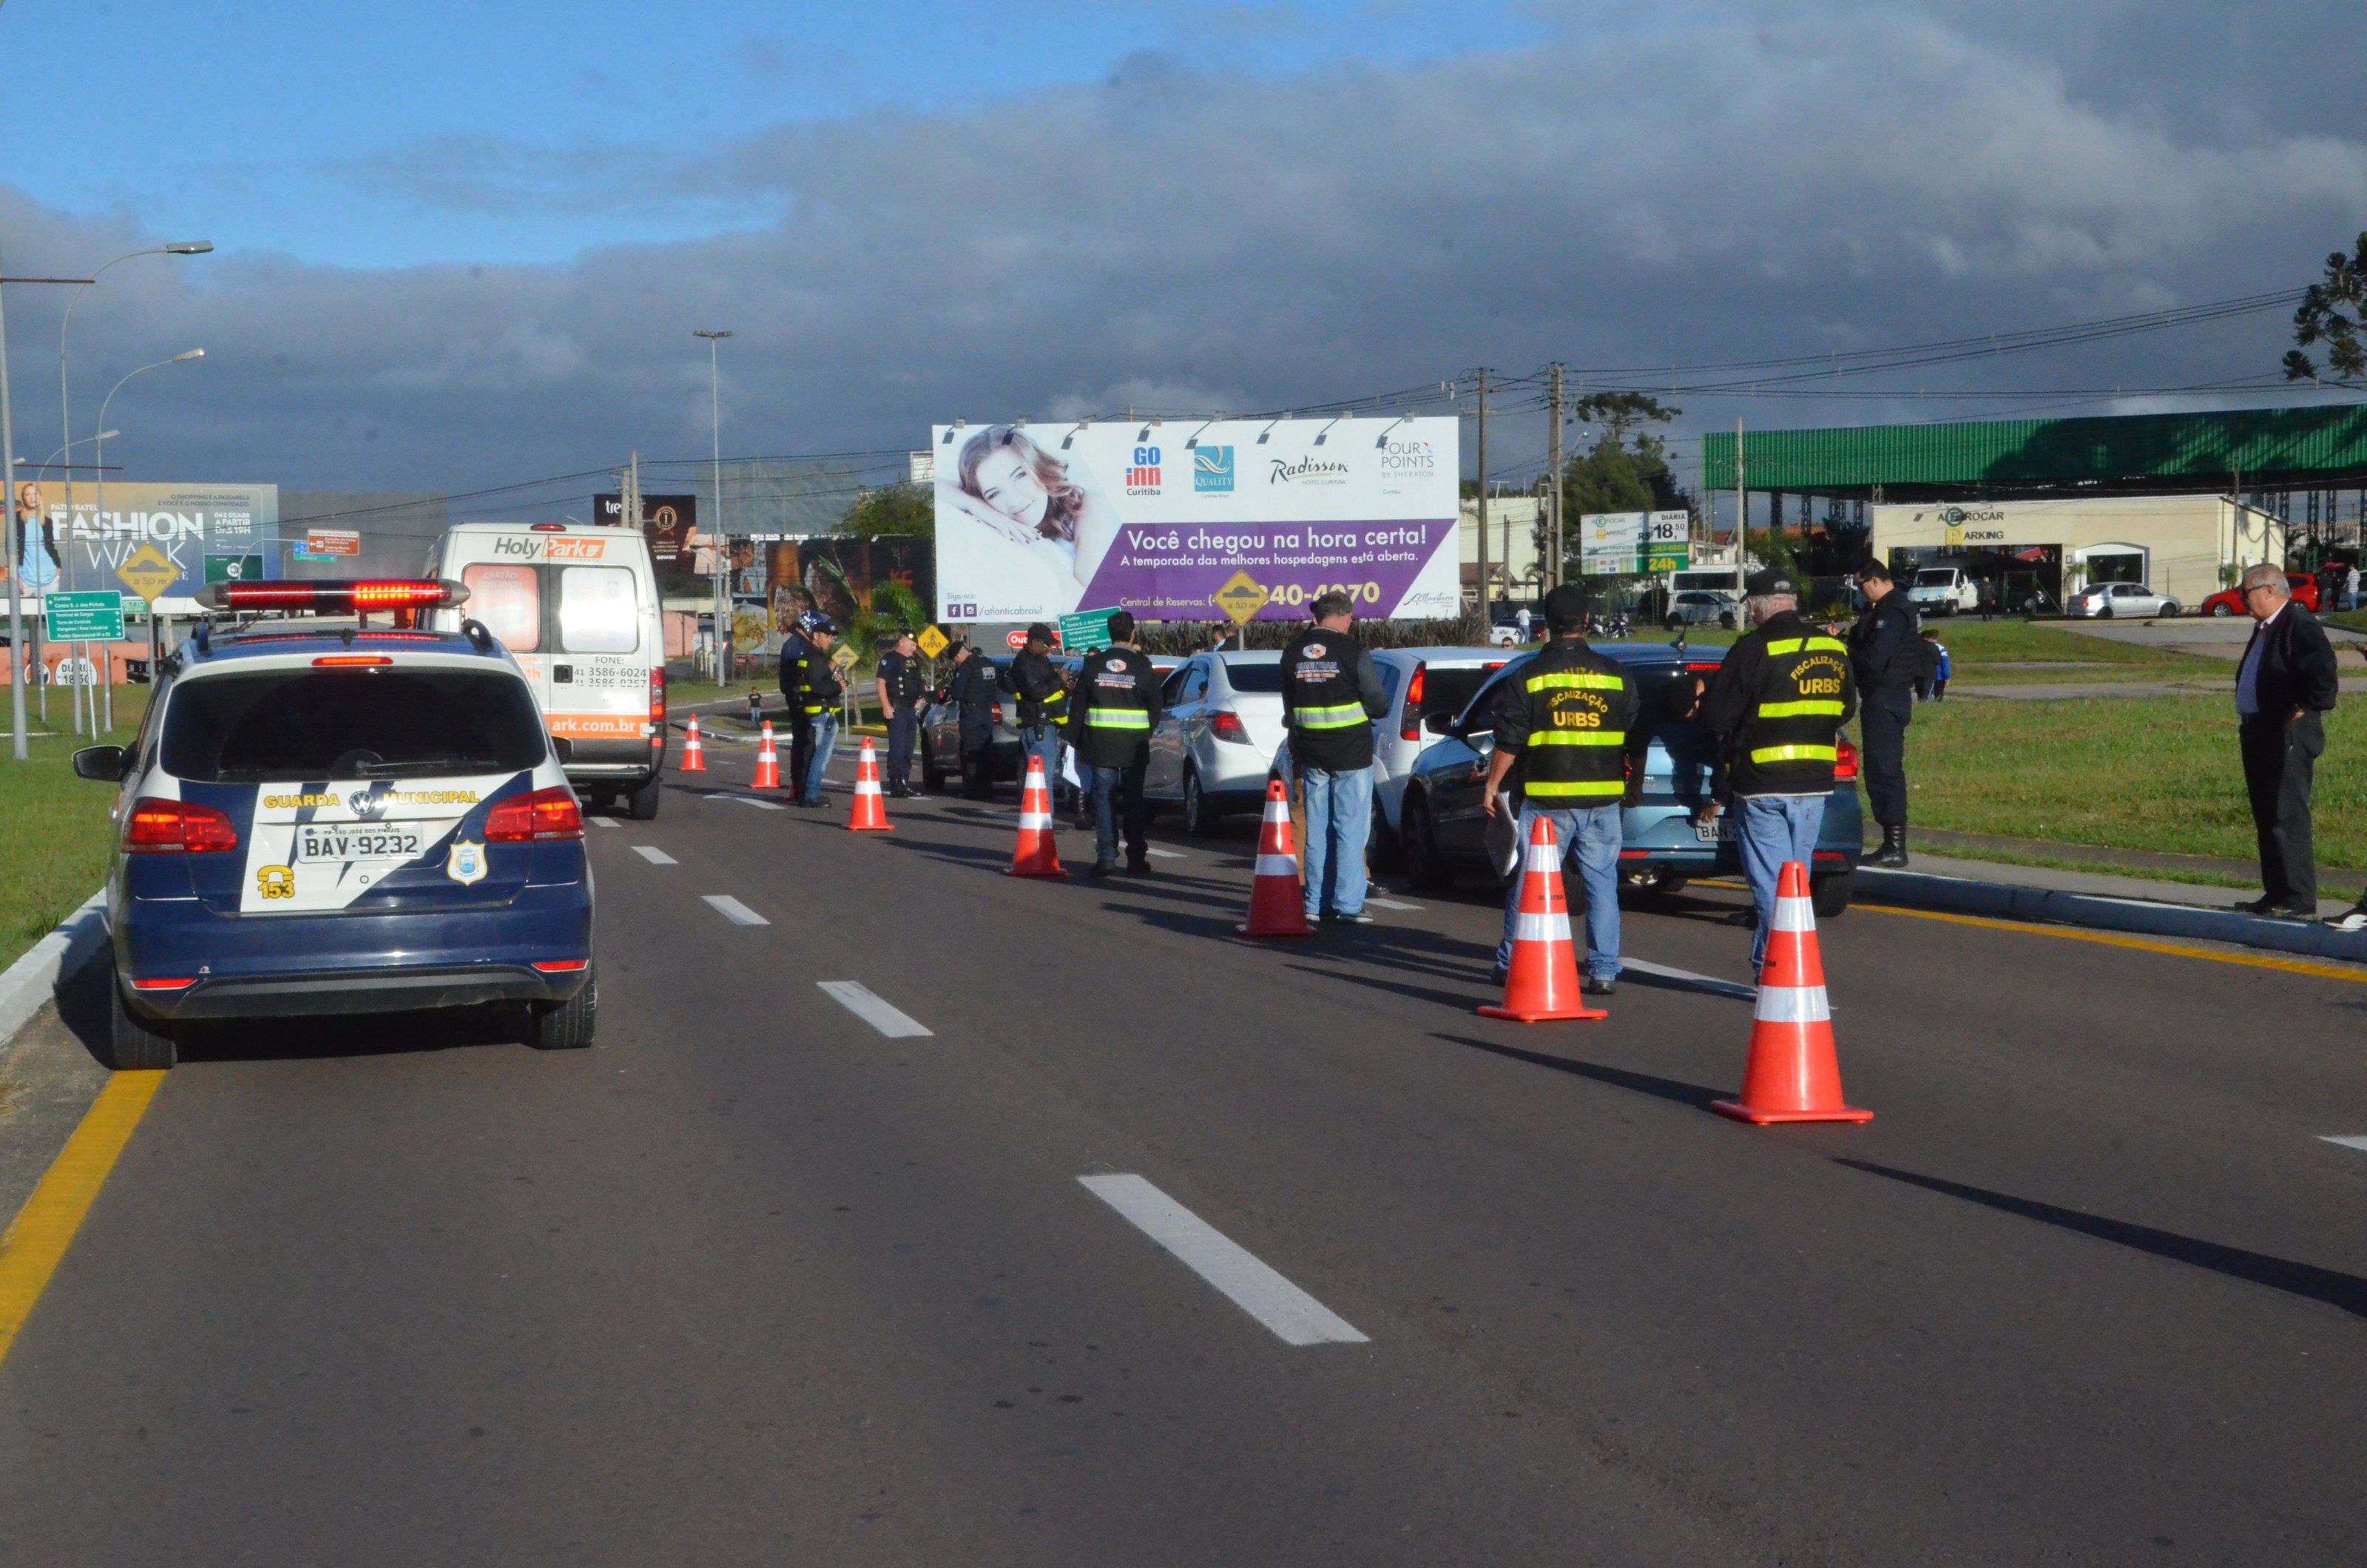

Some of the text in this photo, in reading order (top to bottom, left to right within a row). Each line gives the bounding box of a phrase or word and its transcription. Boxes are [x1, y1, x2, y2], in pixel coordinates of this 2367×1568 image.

[1133, 447, 1161, 465] GO
[1381, 442, 1420, 455] FOUR
[1270, 455, 1348, 485] Radisson
[1382, 456, 1434, 468] POINTS
[1126, 467, 1161, 486] inn
[1195, 477, 1233, 487] QUALITY
[1127, 488, 1161, 496] Curitiba
[50, 512, 203, 541] FASHION
[234, 526, 251, 534] 19H
[494, 537, 584, 559] Holy Park
[1127, 524, 1426, 555] Você chegou na hora certa!
[86, 541, 186, 570] WAK
[1120, 550, 1419, 569] A temporada das melhores hospedagens está aberta.
[1649, 557, 1677, 570] 24h
[1120, 597, 1150, 606] Central
[1152, 596, 1164, 606] de
[1166, 597, 1206, 606] Reservas:
[1258, 581, 1380, 606] 40-470
[589, 667, 646, 677] 3586-6024
[589, 678, 646, 688] 35860257
[1799, 677, 1841, 695] URBS
[552, 718, 636, 732] ark.com.br
[1553, 712, 1601, 727] URBS
[263, 791, 480, 808] GUARDA MUNICIPAL
[257, 881, 295, 899] 153
